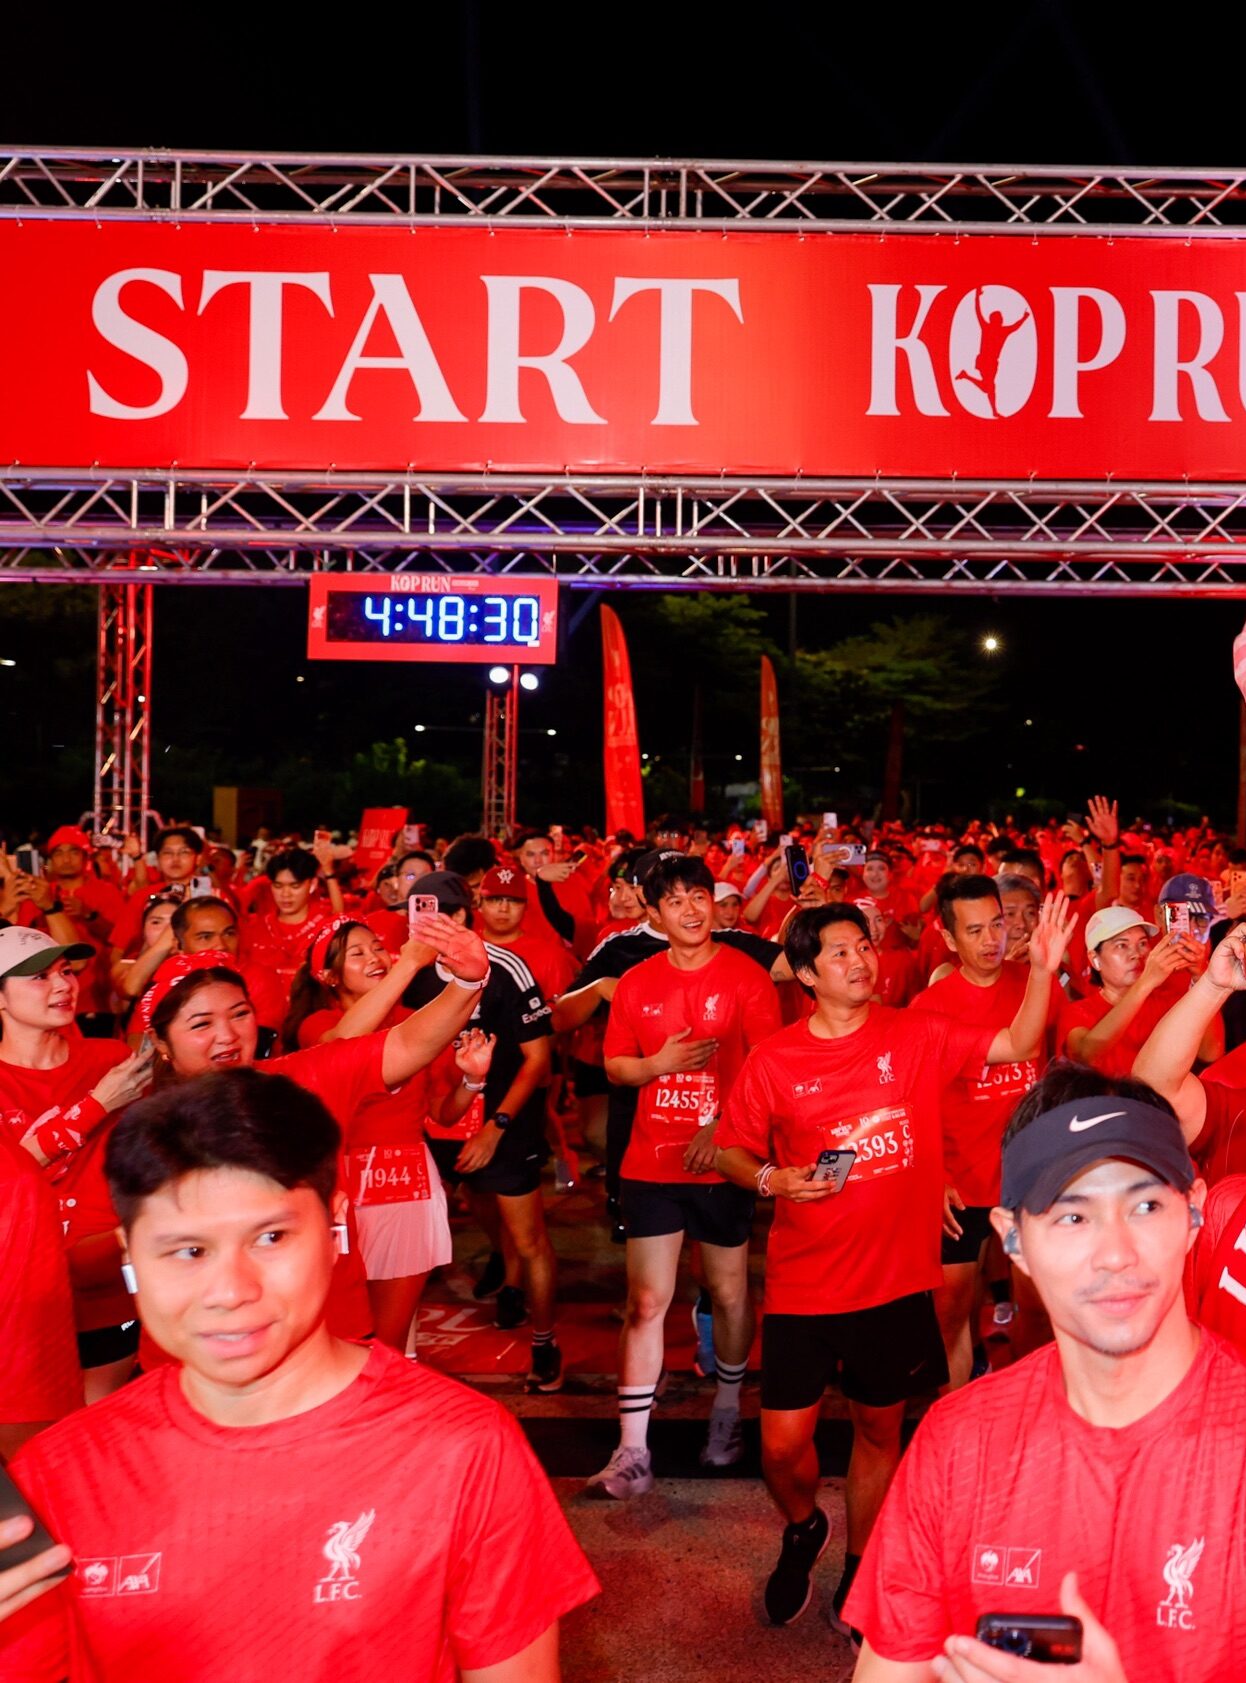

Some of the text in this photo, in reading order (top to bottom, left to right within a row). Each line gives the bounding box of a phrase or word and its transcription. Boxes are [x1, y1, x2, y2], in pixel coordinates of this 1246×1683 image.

[86, 268, 744, 426] START
[865, 283, 1127, 420] KOP
[391, 575, 421, 592] KOP
[421, 576, 451, 593] RUN
[364, 596, 539, 642] 4:48:30
[655, 1088, 701, 1110] 12455
[838, 1130, 899, 1164] 2393
